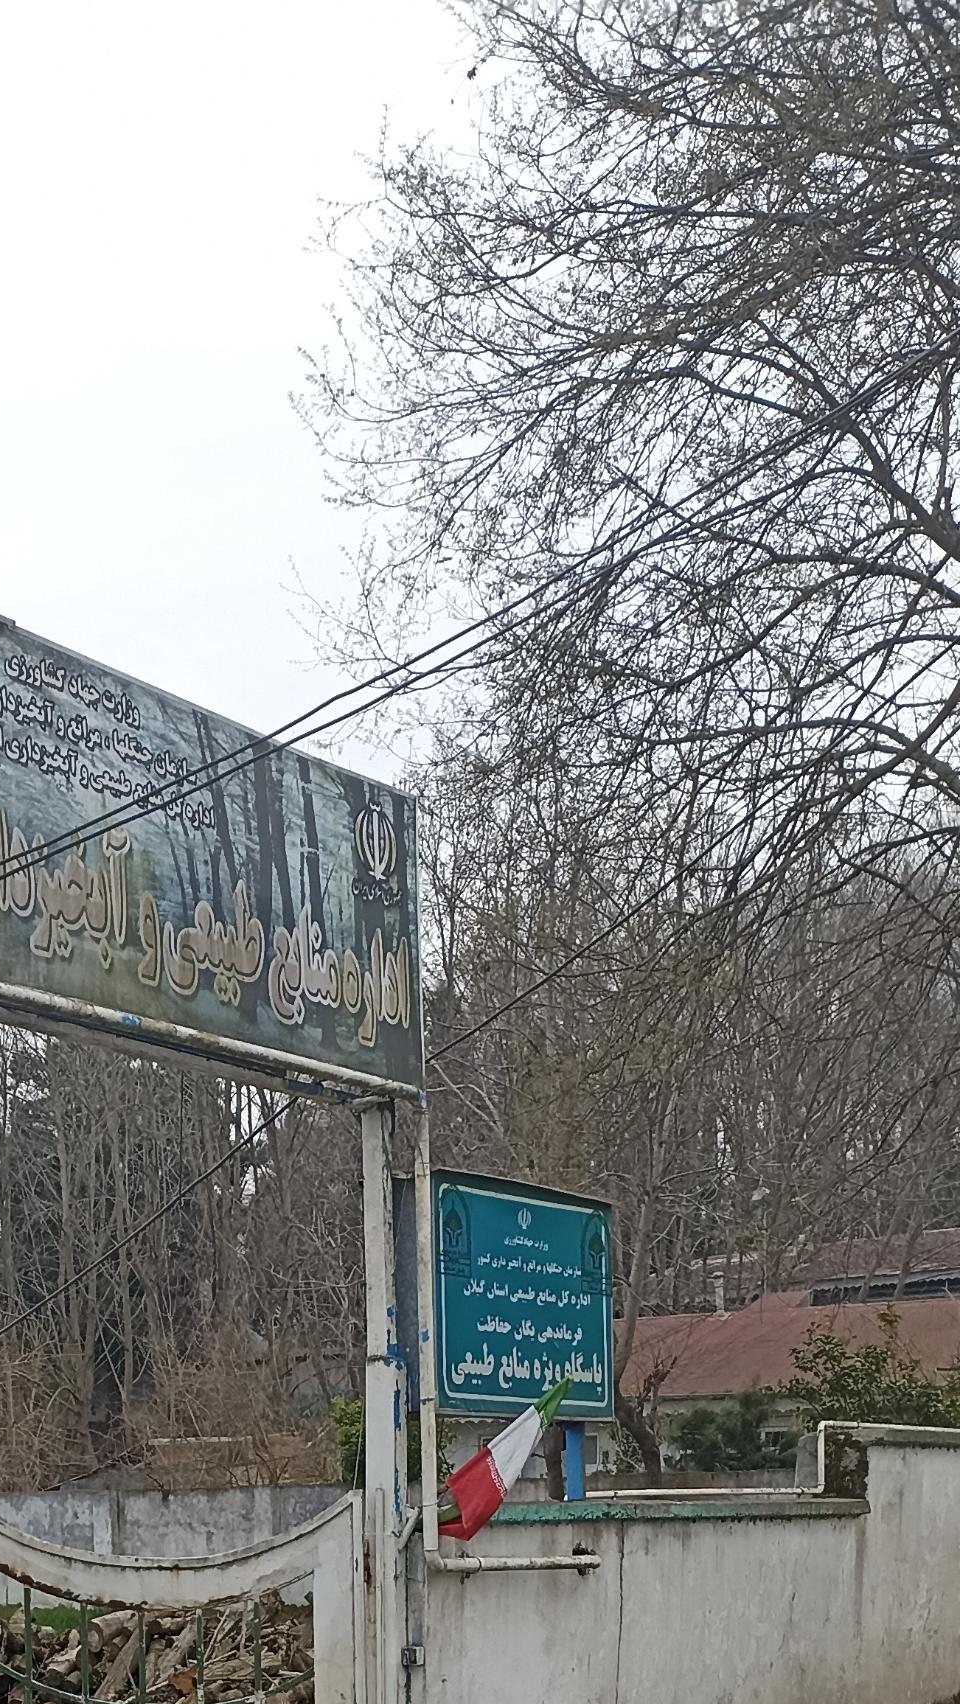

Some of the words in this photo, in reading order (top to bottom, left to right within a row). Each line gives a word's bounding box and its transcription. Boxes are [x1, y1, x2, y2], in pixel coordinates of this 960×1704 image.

[4, 655, 66, 691] کشاورزی
[68, 674, 100, 712] جهاد
[102, 690, 140, 730] وزارت
[56, 716, 66, 741] و
[67, 714, 102, 752] مراتع
[5, 736, 78, 781] آبخیزداری
[112, 728, 153, 773] جنگلها
[79, 765, 90, 789] و
[90, 770, 132, 799] طبیعی
[139, 891, 161, 988] و
[163, 879, 265, 1006] طبیعی
[269, 904, 340, 1025] منابع
[343, 928, 411, 1047] اداره
[463, 1278, 486, 1297] گیلان
[486, 1281, 509, 1299] استان
[509, 1286, 536, 1304] طبیعی
[557, 1289, 569, 1307] کل
[476, 1314, 512, 1335] حفاظت
[514, 1319, 536, 1343] یگان
[538, 1324, 583, 1348] فرماندهی
[451, 1343, 495, 1386] طبیعی
[498, 1346, 531, 1389] منابع
[564, 1351, 603, 1396] پاسگاه
